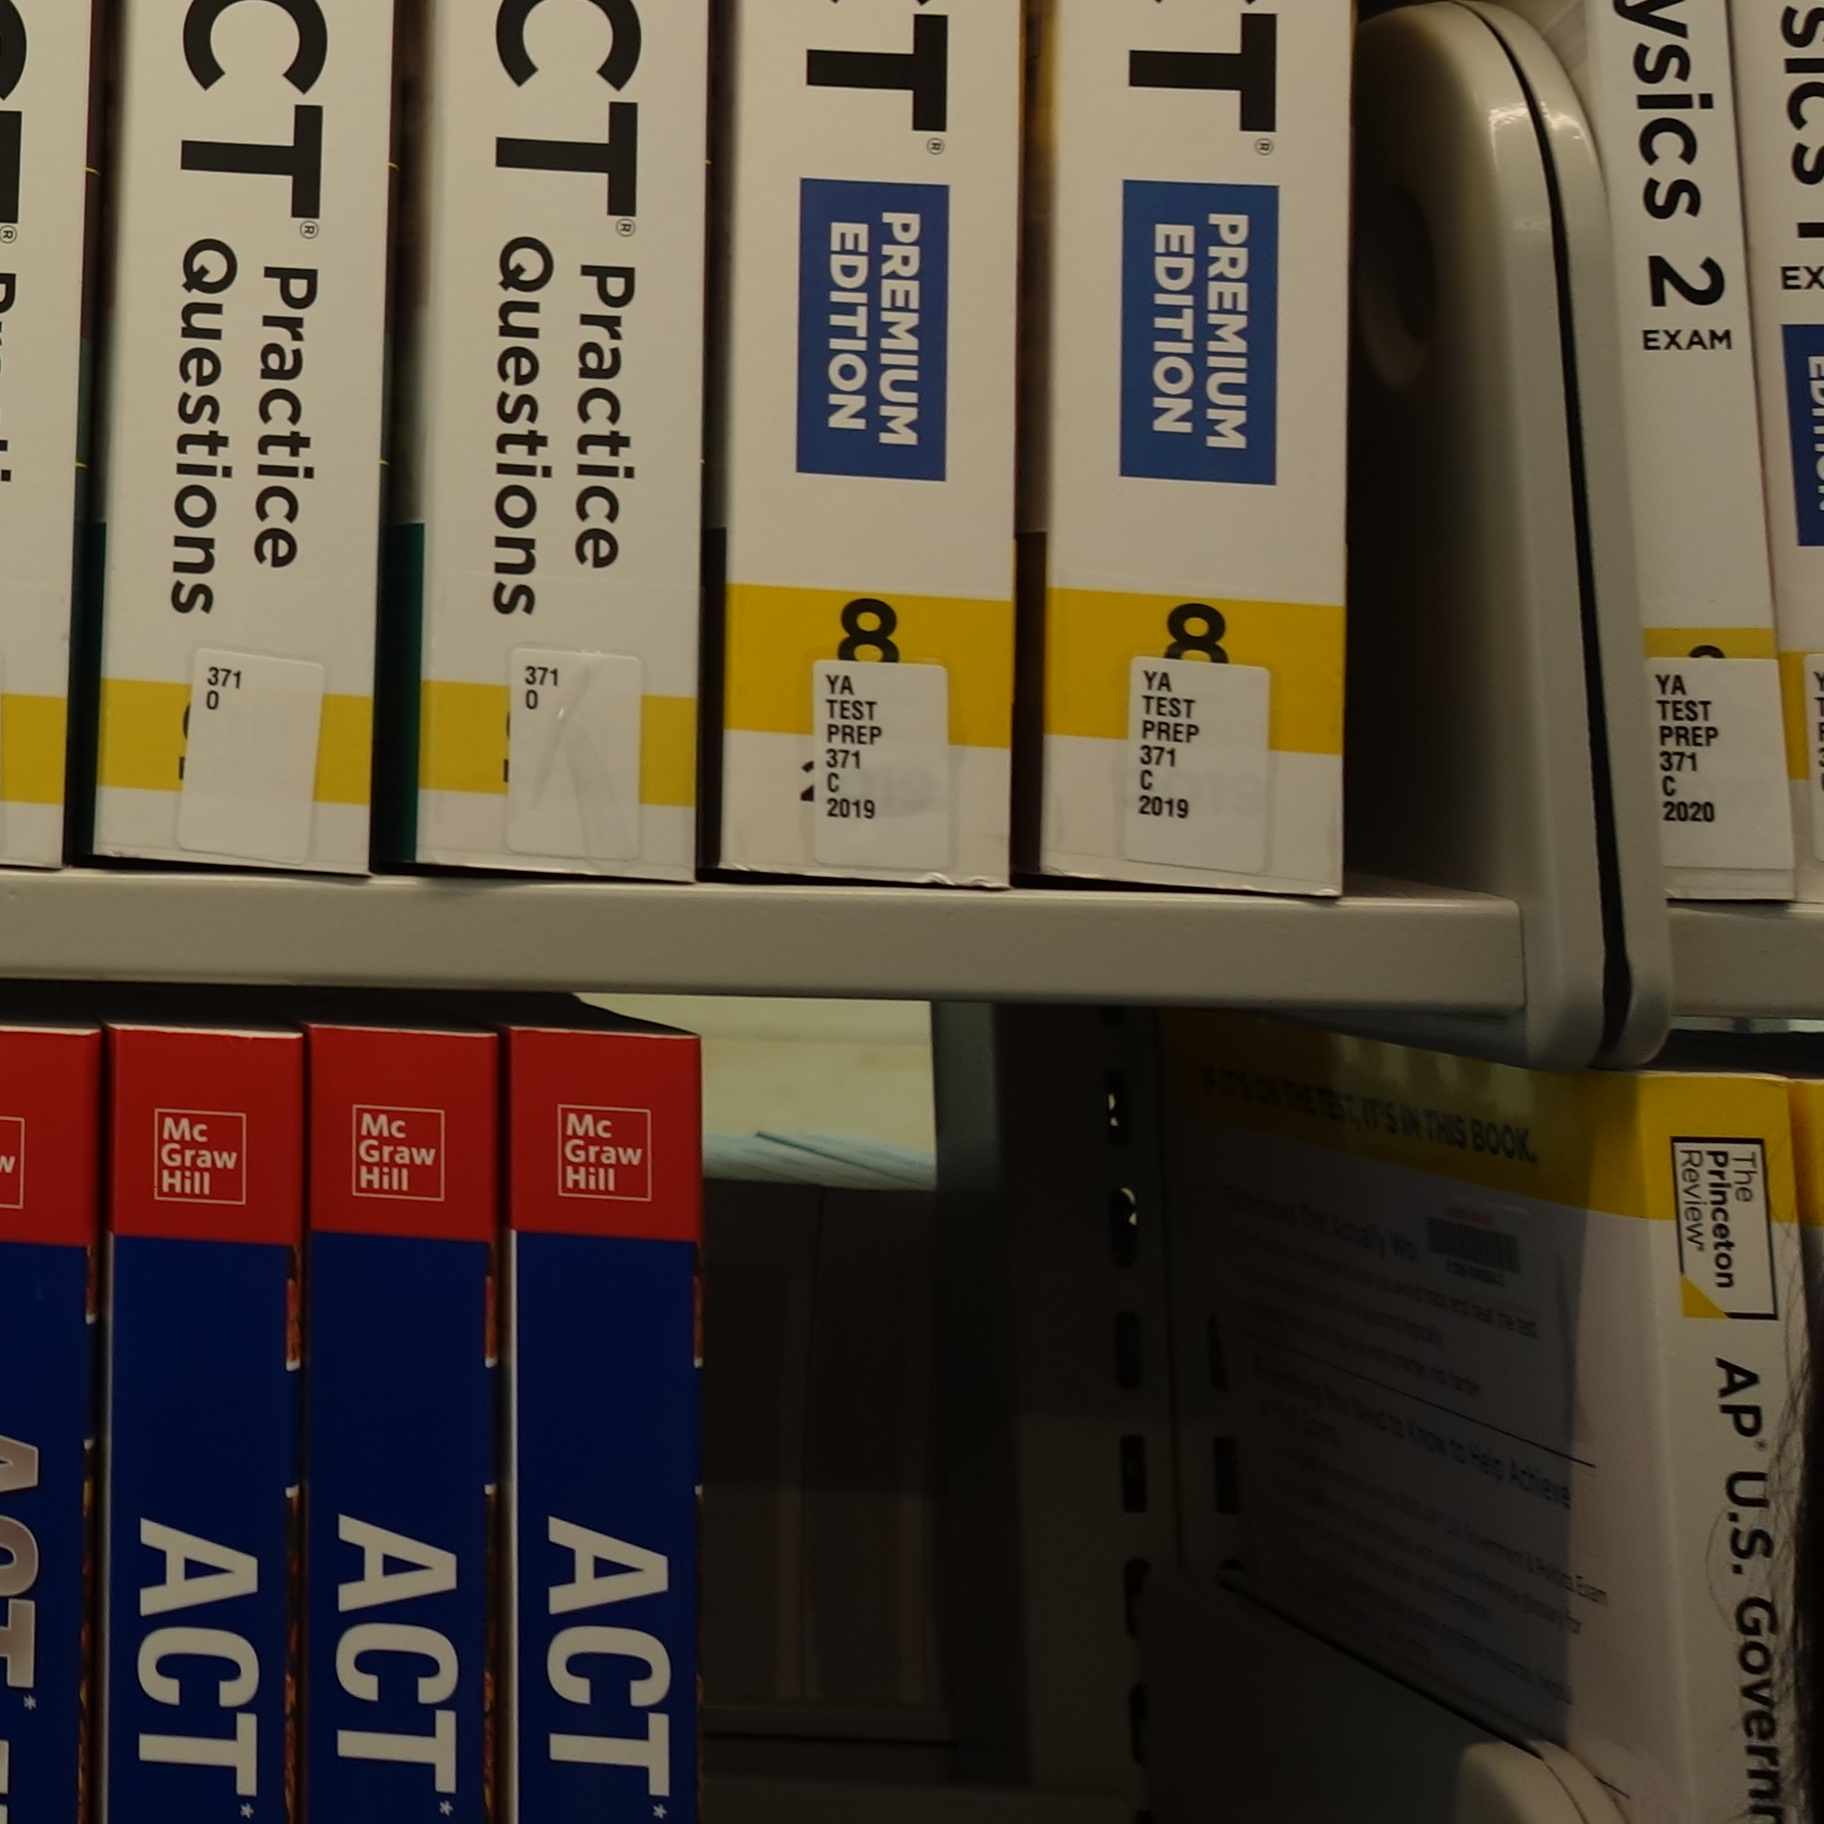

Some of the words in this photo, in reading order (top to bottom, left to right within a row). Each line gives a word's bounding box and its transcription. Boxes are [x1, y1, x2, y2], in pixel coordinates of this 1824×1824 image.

[1648, 255, 1726, 307] 2
[1152, 223, 1195, 433] EDITION
[1205, 213, 1249, 449] PREMIUM
[1642, 329, 1733, 351] EXAM
[492, 236, 554, 615] Questions
[574, 264, 636, 569] Practice
[1143, 670, 1172, 693] YA
[1654, 673, 1687, 696] YA
[1141, 694, 1196, 719] TEST
[1655, 699, 1712, 722] TEST
[1141, 719, 1200, 744] PREP
[1658, 724, 1719, 748] PREP
[1139, 744, 1176, 768] 371
[1658, 750, 1698, 772] 371
[1139, 768, 1154, 791] C
[1661, 775, 1677, 797] C
[1138, 794, 1190, 820] 2019
[1662, 800, 1716, 823] 2020
[1706, 1150, 1744, 1289] Princeton
[1725, 1471, 1775, 1575] U.S.
